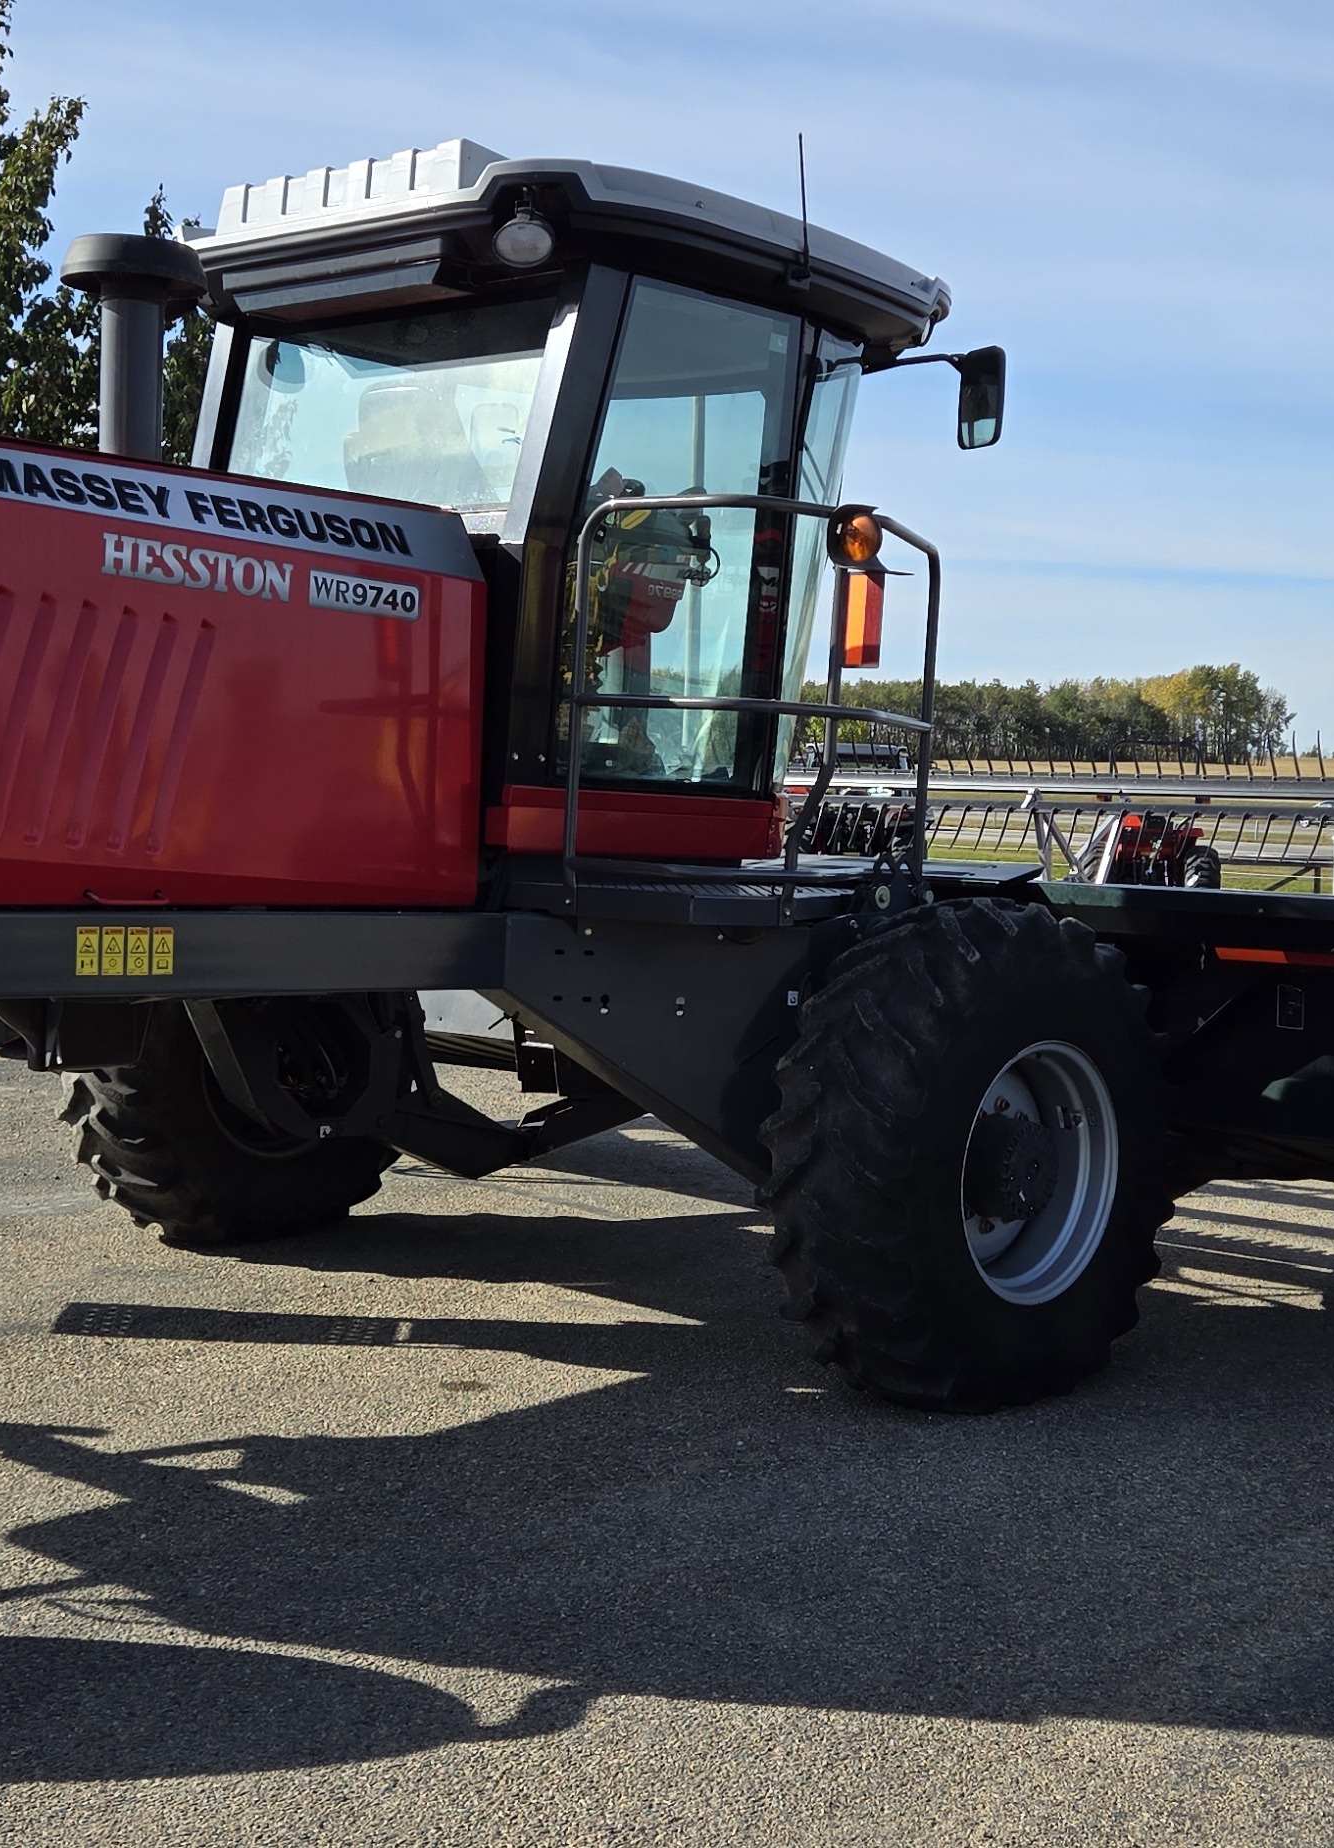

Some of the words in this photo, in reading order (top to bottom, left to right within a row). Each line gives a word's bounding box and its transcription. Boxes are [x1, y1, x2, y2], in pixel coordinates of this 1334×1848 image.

[184, 489, 413, 557] FERGUSON
[101, 531, 294, 603] HESSTON
[312, 574, 417, 615] WR9740
